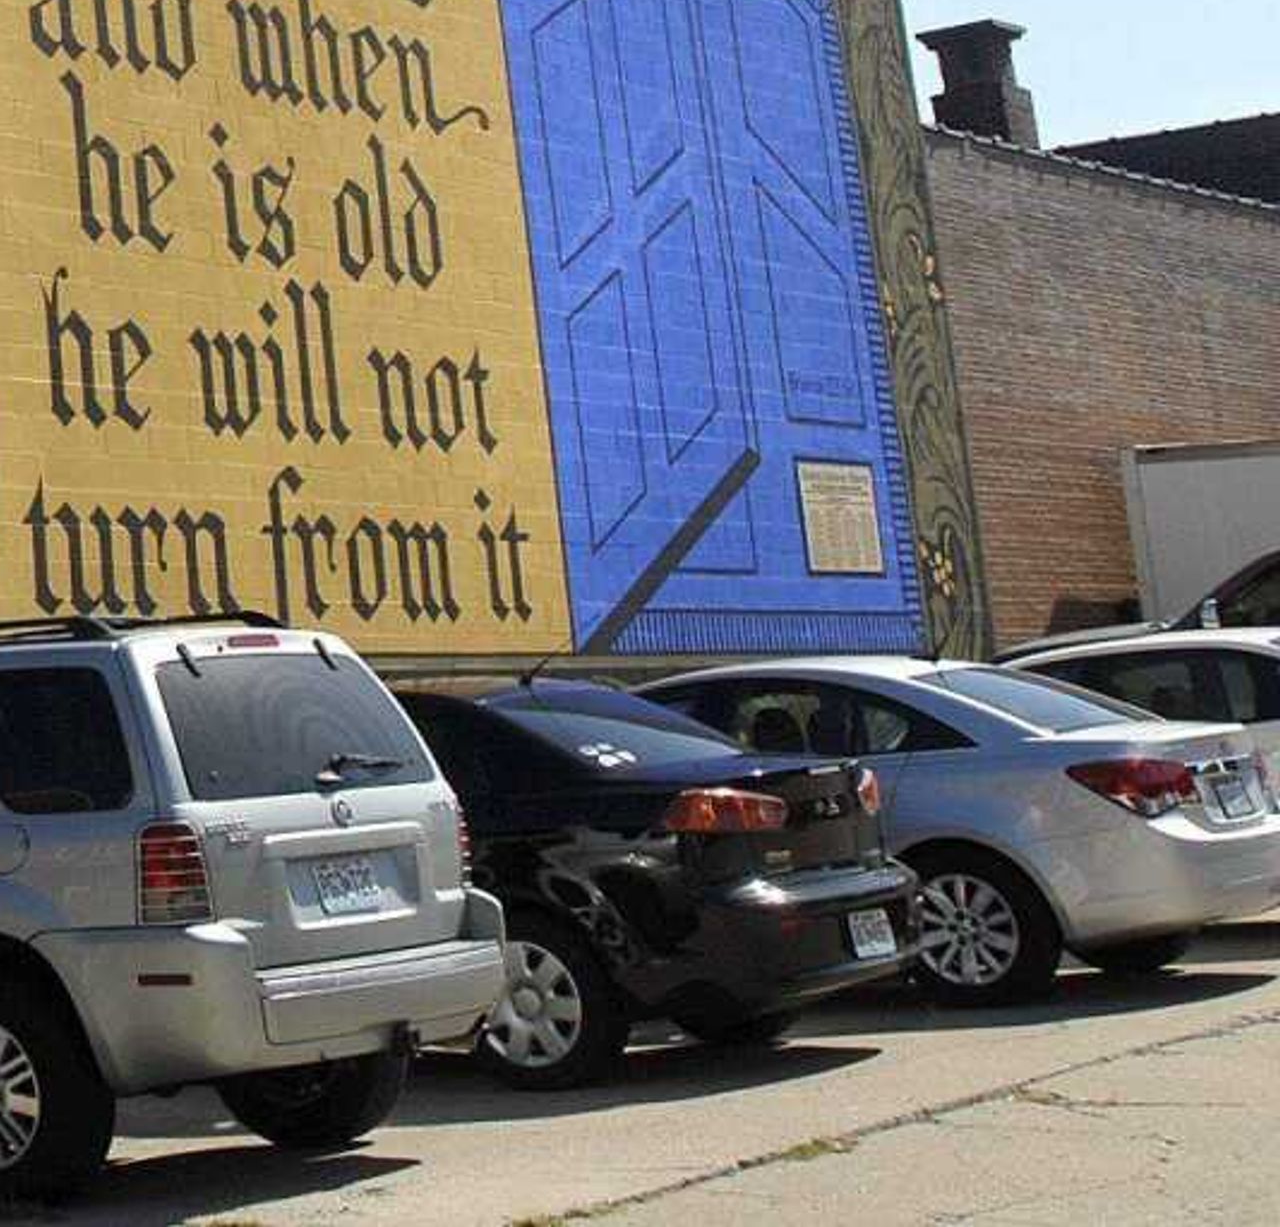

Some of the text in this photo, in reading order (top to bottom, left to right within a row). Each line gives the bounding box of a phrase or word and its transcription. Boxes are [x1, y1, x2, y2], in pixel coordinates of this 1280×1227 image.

[60, 69, 445, 290] he is old
[40, 266, 498, 455] he will not
[22, 465, 534, 624] turn from it
